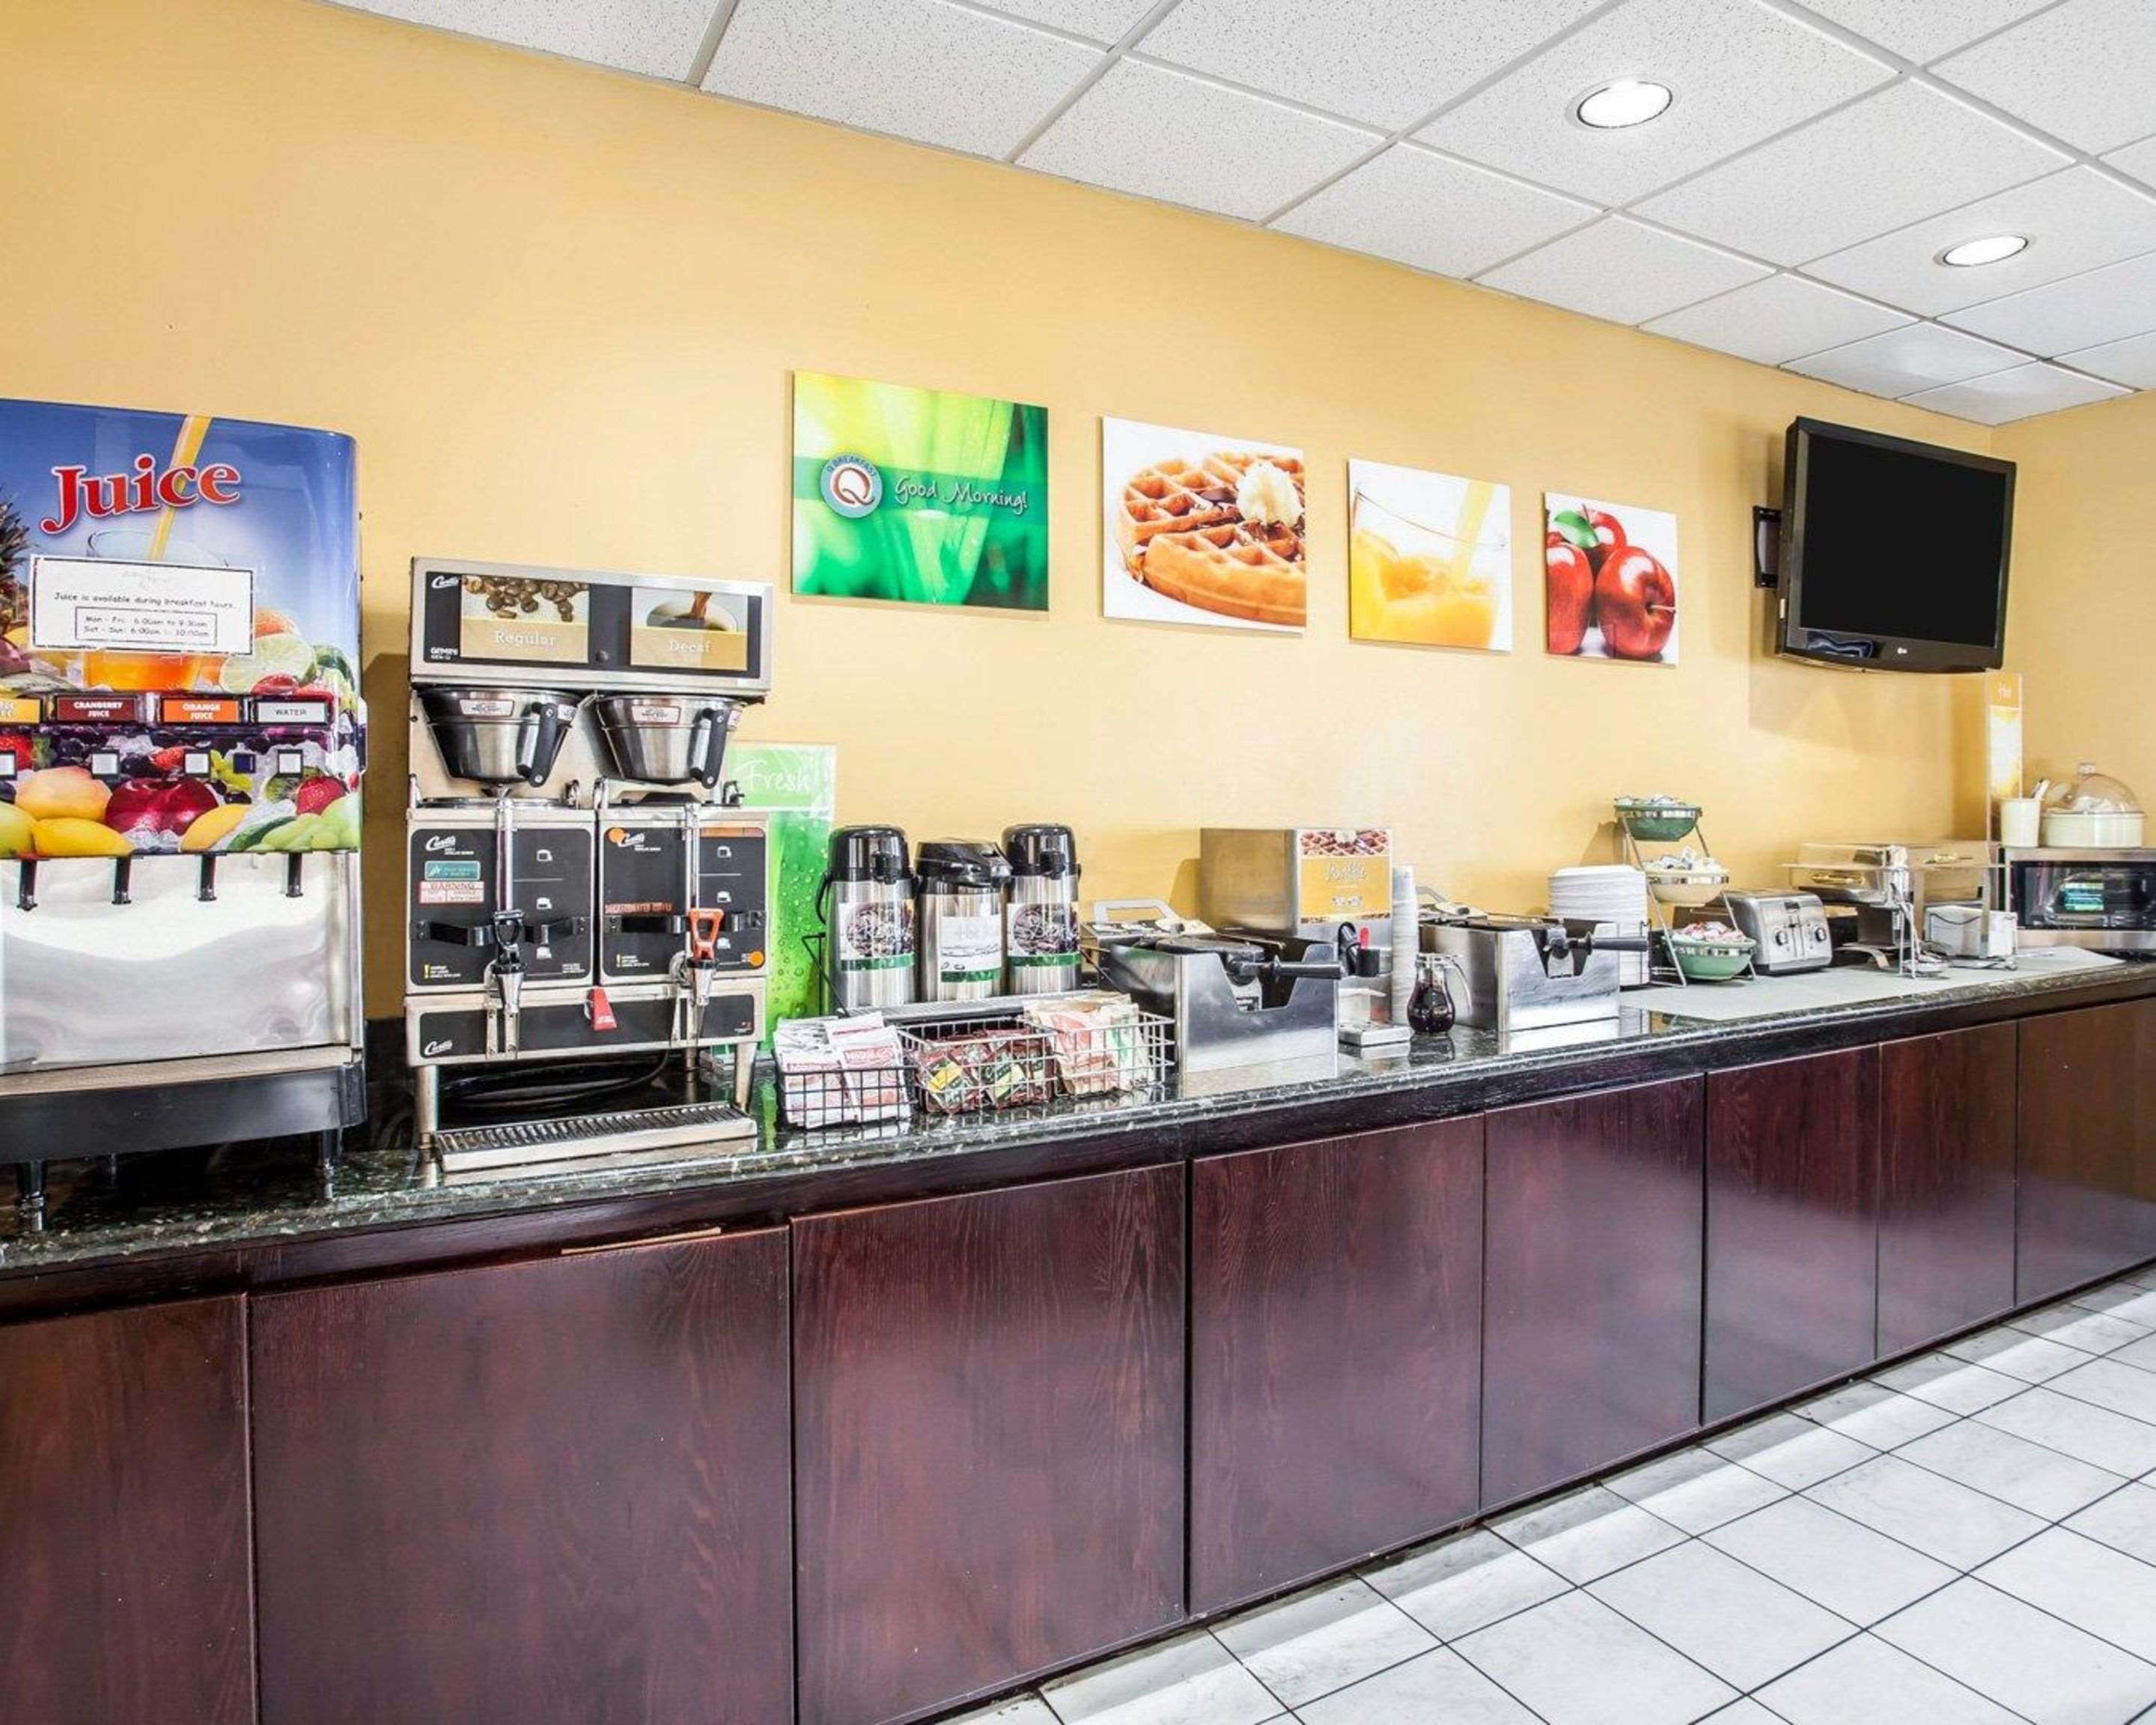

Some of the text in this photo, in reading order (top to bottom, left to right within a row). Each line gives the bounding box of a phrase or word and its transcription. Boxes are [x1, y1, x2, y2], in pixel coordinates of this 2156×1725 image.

[832, 466, 875, 506] Q
[40, 454, 241, 534] Juice
[895, 475, 1028, 515] Good Morning!
[54, 592, 78, 601] Juice
[93, 594, 130, 603] available
[134, 597, 162, 606] during
[164, 598, 207, 607] breakfast
[493, 629, 556, 648] Regular
[669, 639, 711, 654] Decaf
[73, 701, 124, 710] CRANBERRY
[182, 702, 221, 711] ORANGE
[275, 708, 307, 717] WATER
[88, 710, 110, 718] JUICE
[190, 711, 214, 720] JUICE
